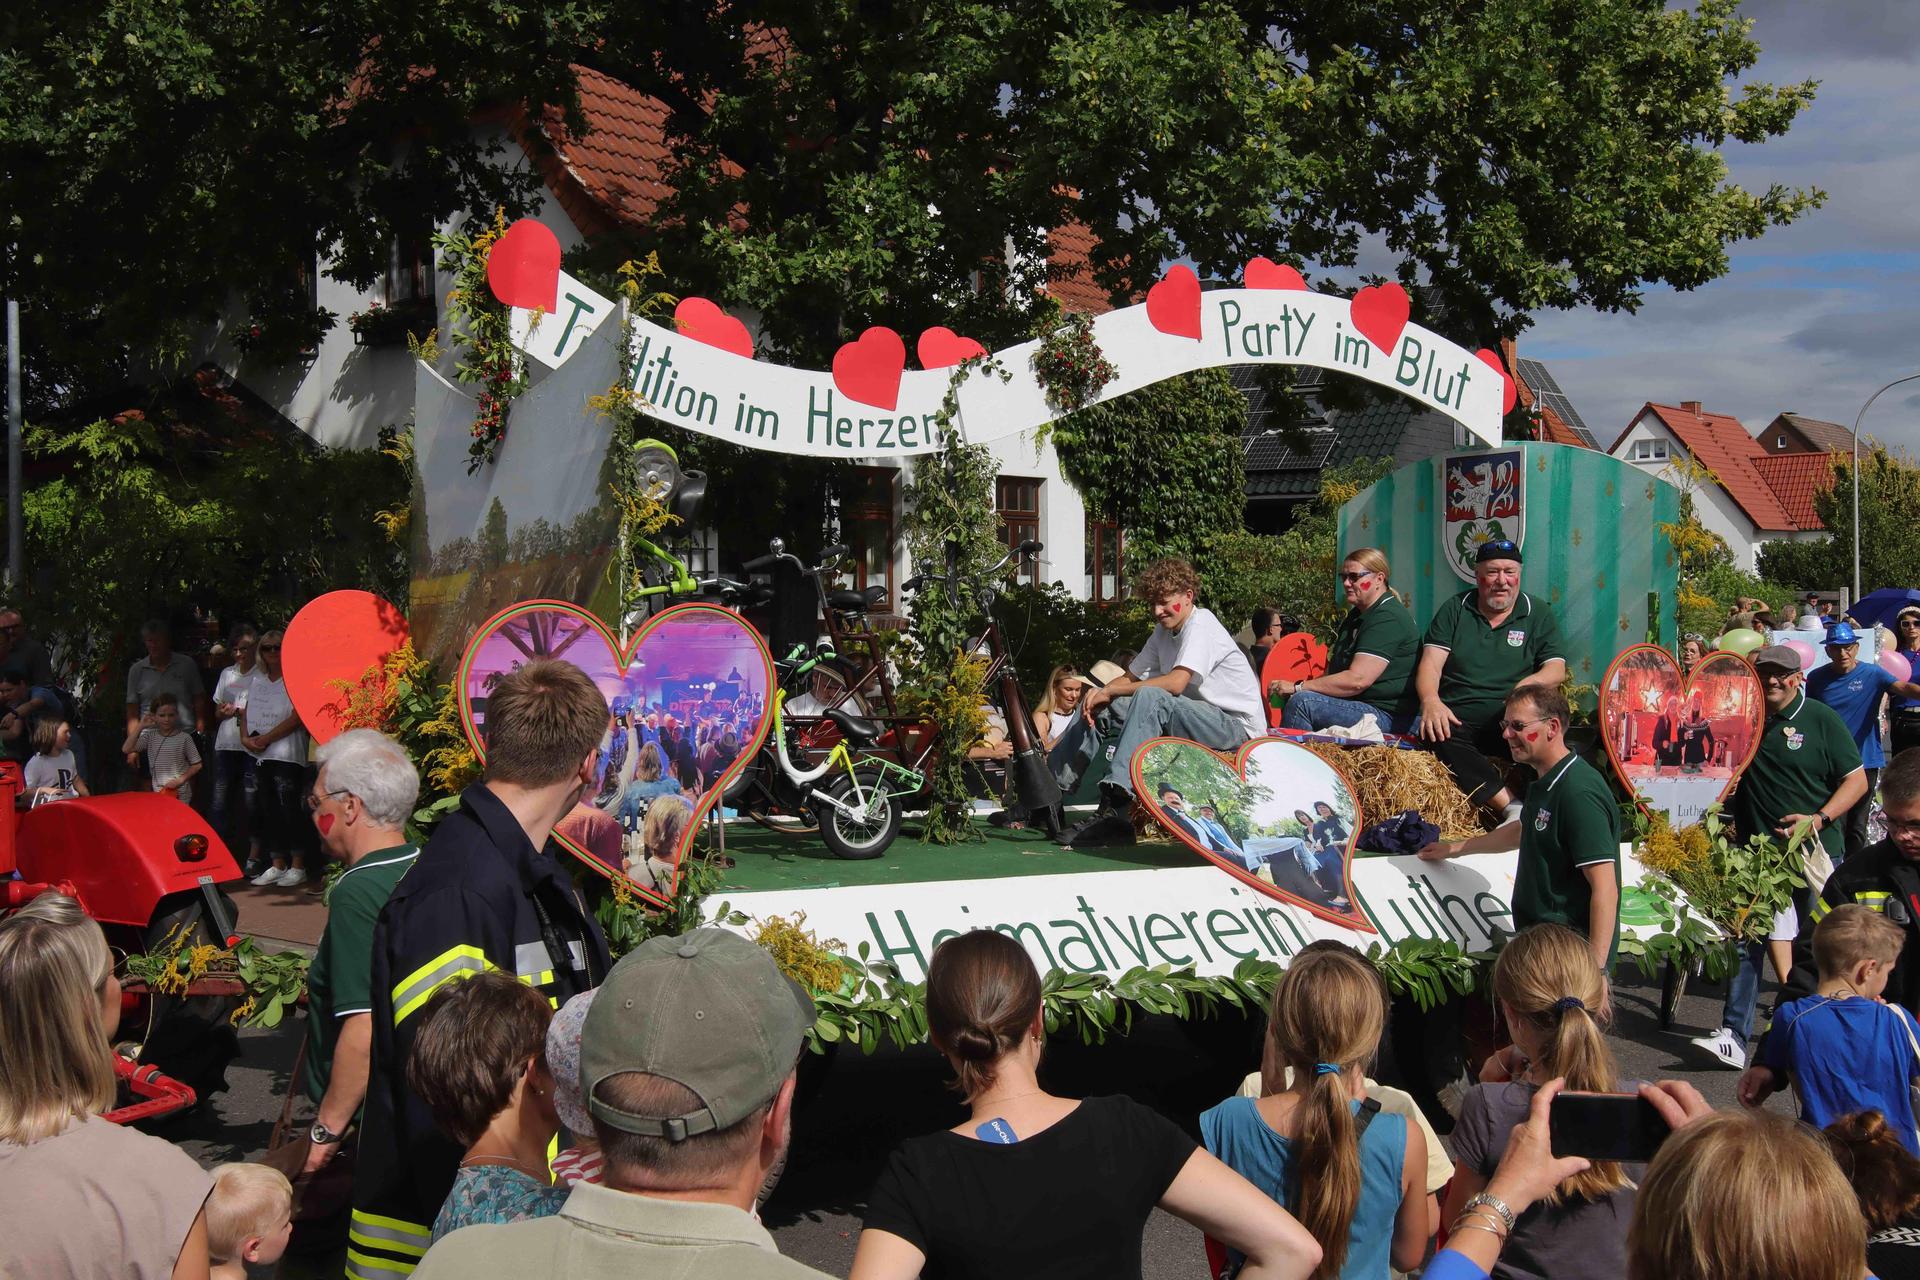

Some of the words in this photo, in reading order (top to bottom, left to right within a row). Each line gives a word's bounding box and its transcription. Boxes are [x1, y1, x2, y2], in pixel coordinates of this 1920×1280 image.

[1219, 299, 1316, 357] Party
[1334, 321, 1369, 369] im
[1395, 335, 1471, 410] Blut
[734, 392, 779, 441] im
